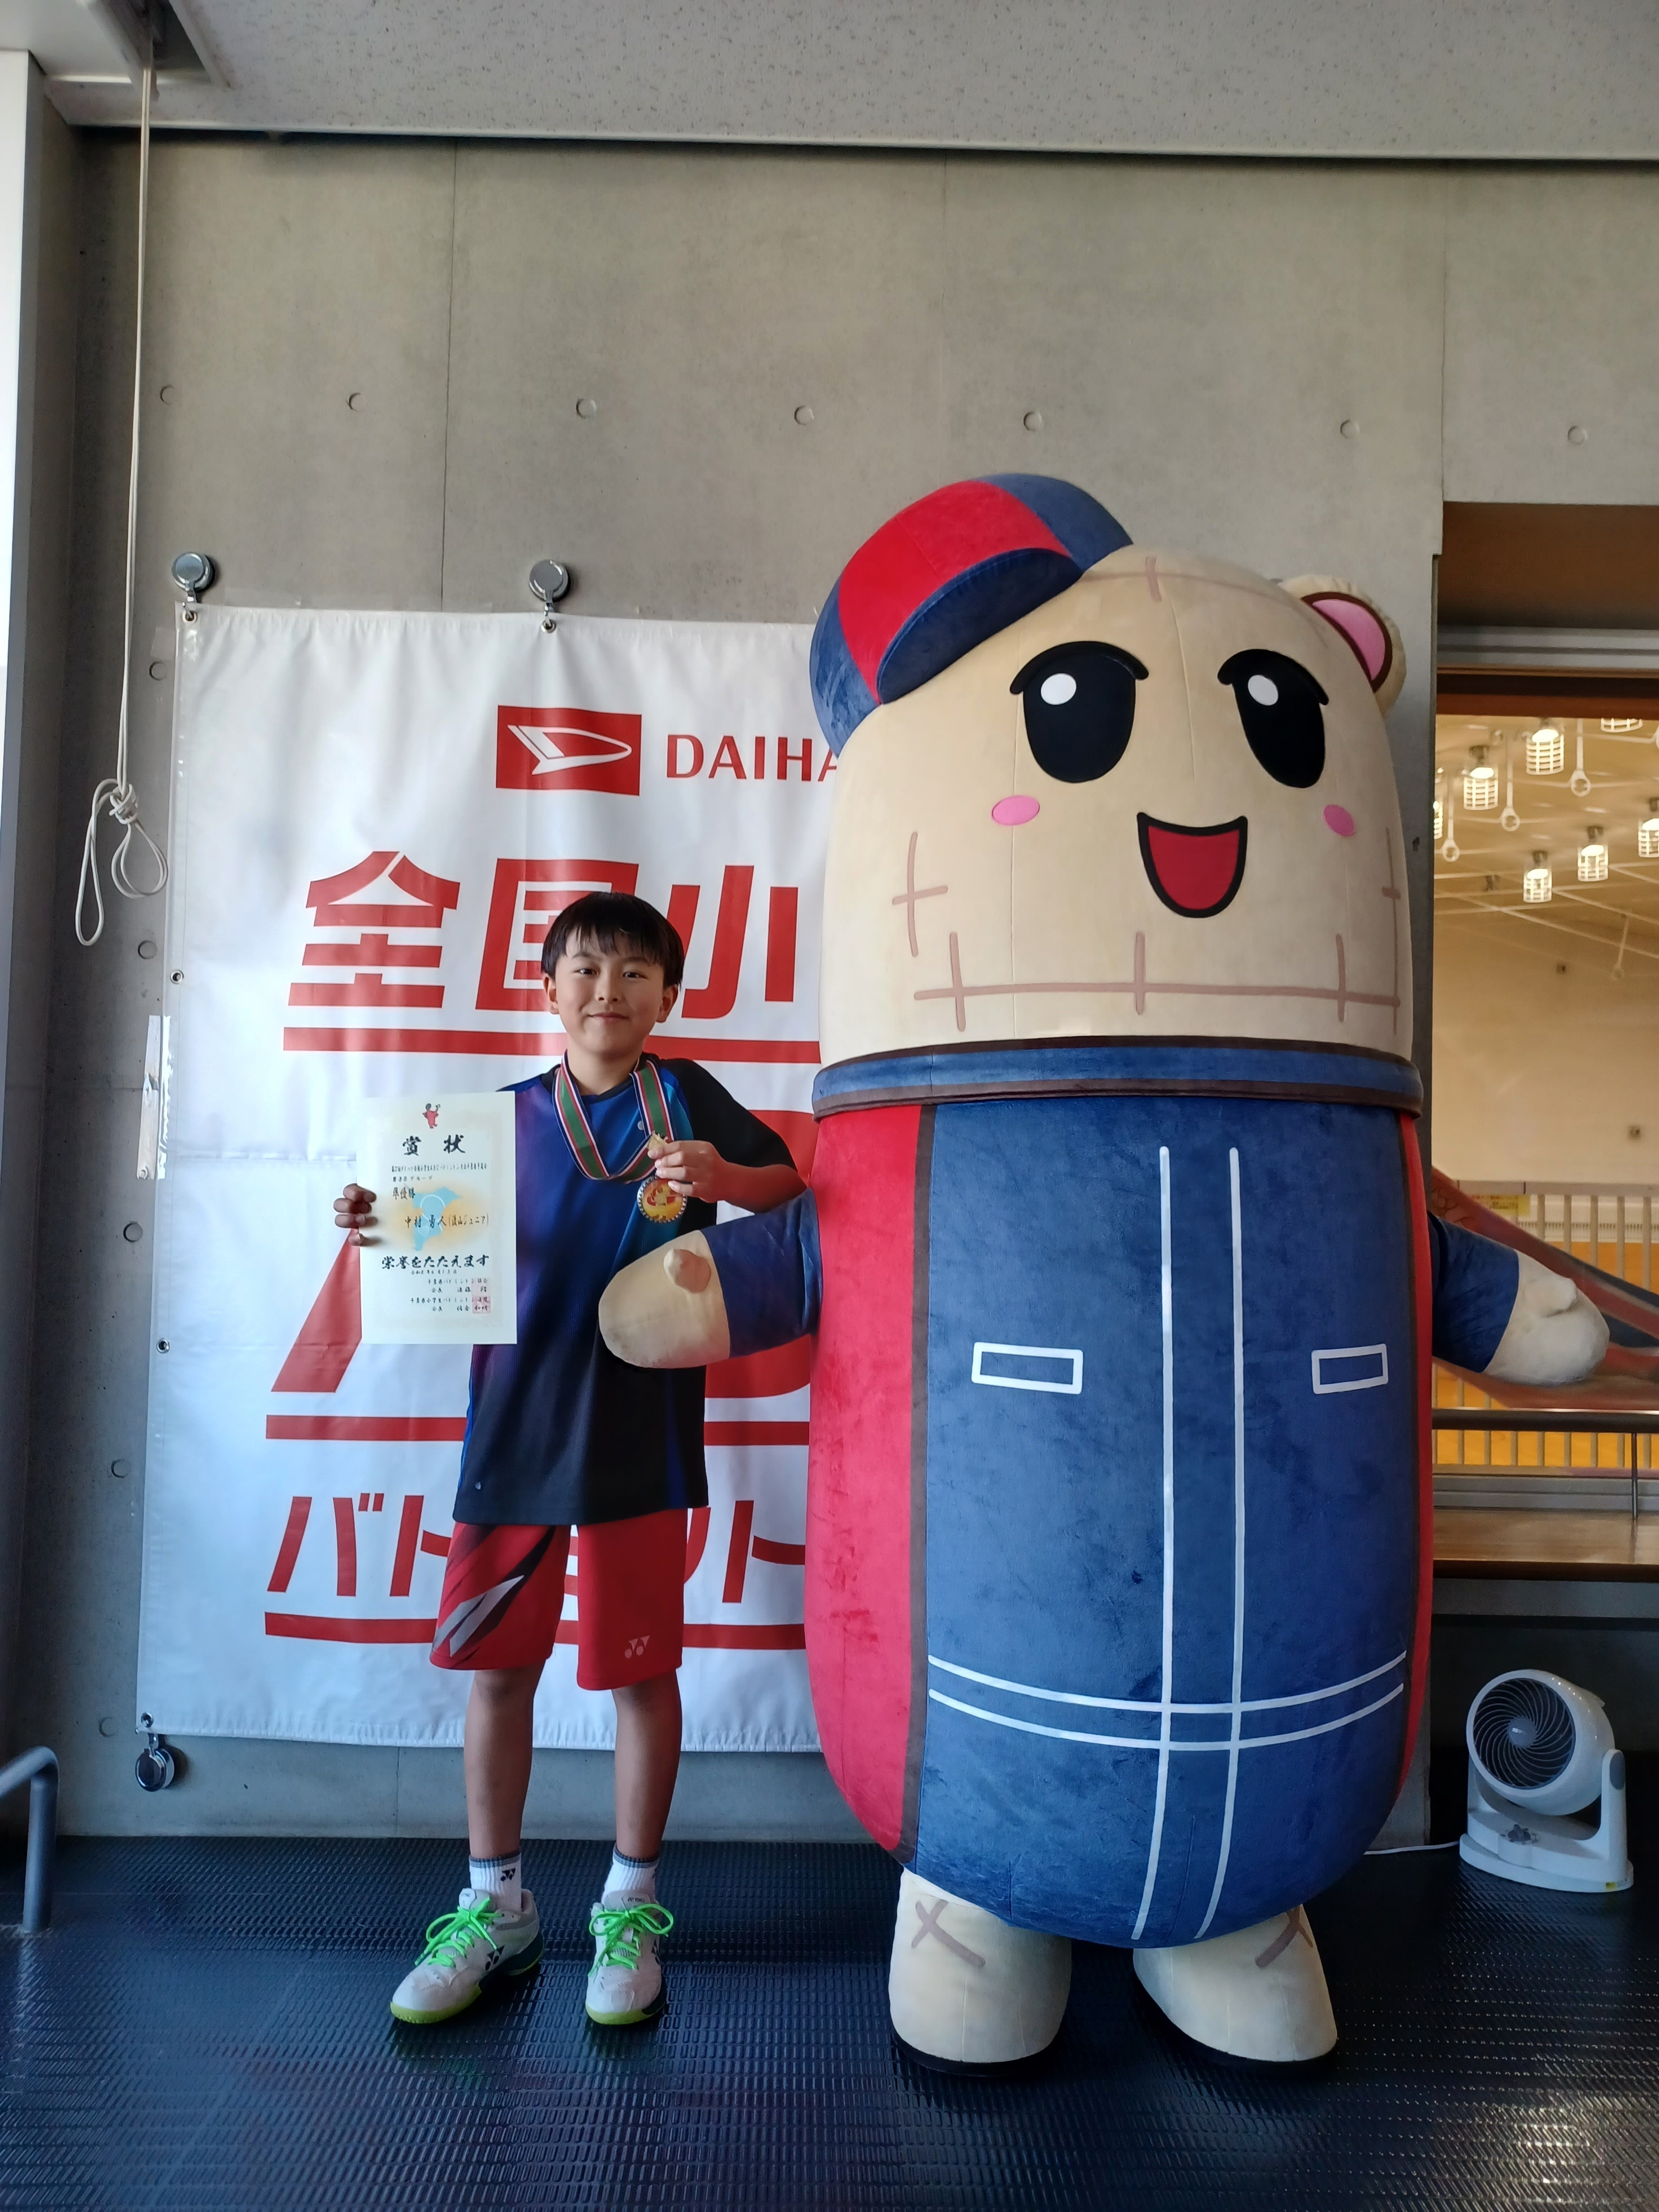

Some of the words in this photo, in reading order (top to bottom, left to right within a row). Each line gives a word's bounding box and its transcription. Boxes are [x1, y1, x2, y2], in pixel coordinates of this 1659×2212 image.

[402, 1134, 466, 1156] 賞状
[382, 1254, 489, 1269] 栄誉をたたえます
